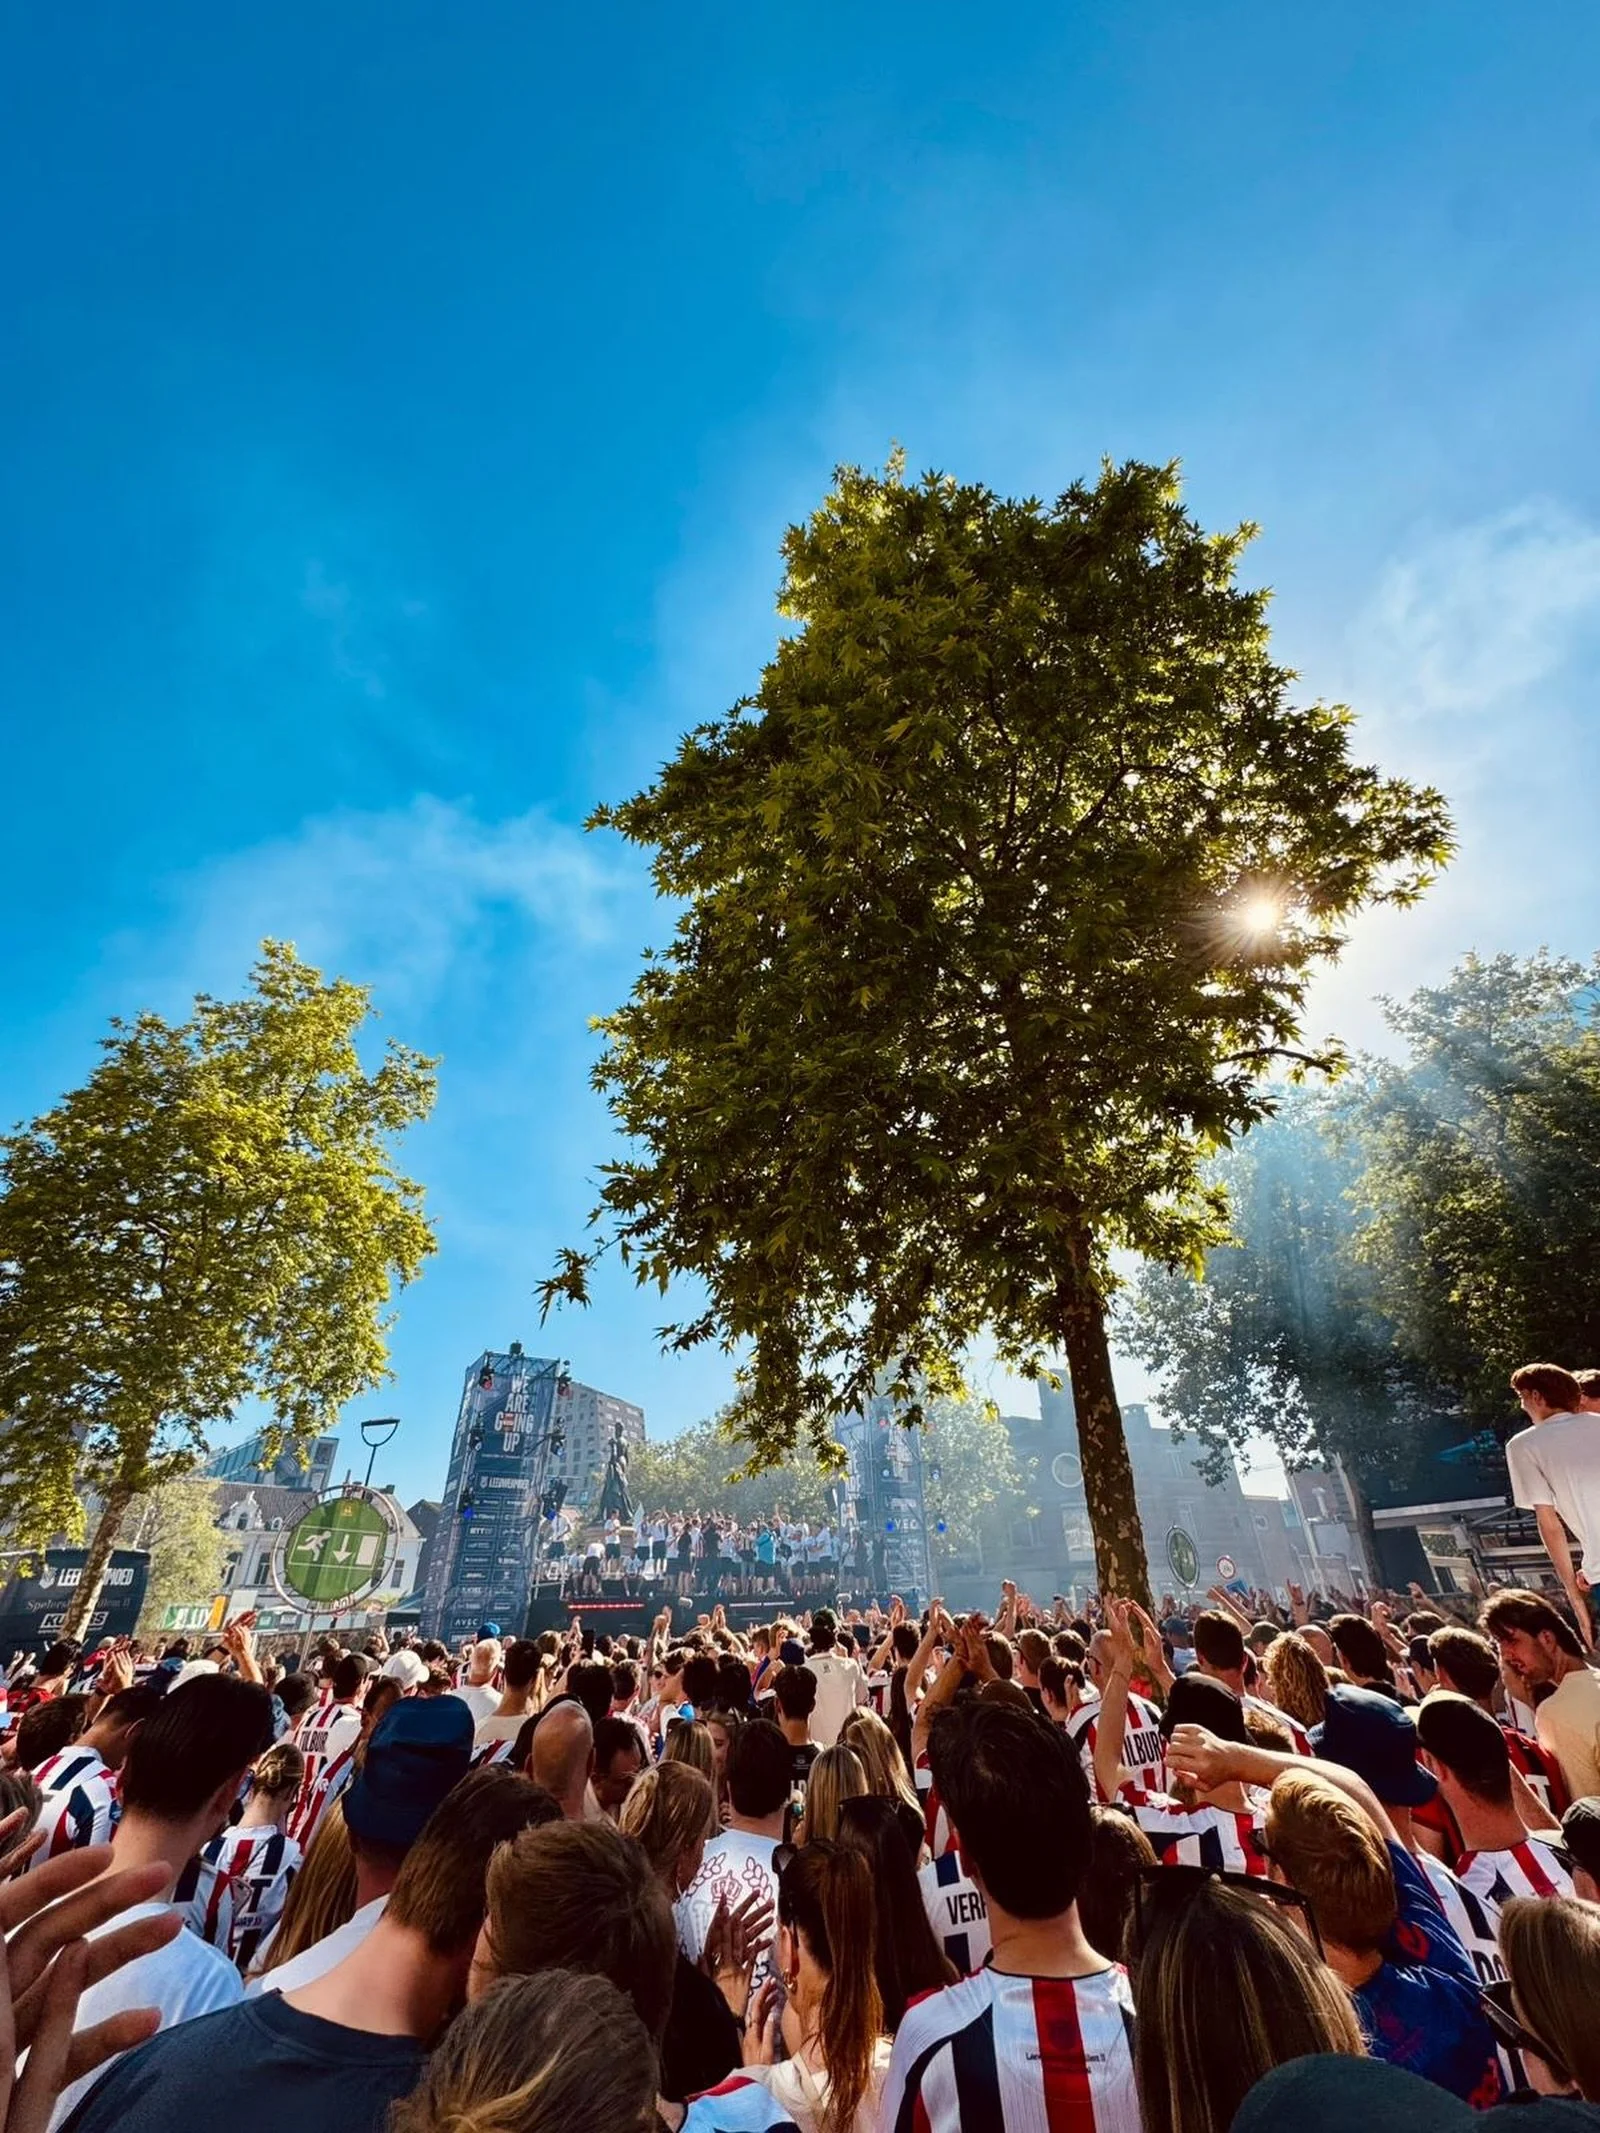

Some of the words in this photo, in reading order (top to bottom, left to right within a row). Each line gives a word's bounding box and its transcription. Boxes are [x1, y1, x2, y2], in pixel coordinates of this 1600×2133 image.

[511, 1370, 530, 1393] WE
[504, 1392, 530, 1413] ARE
[494, 1411, 534, 1433] GING
[502, 1433, 520, 1452] UP
[455, 1618, 479, 1626] AVEC
[301, 1730, 329, 1753] TILBUR
[1121, 1730, 1163, 1768] ILBUR
